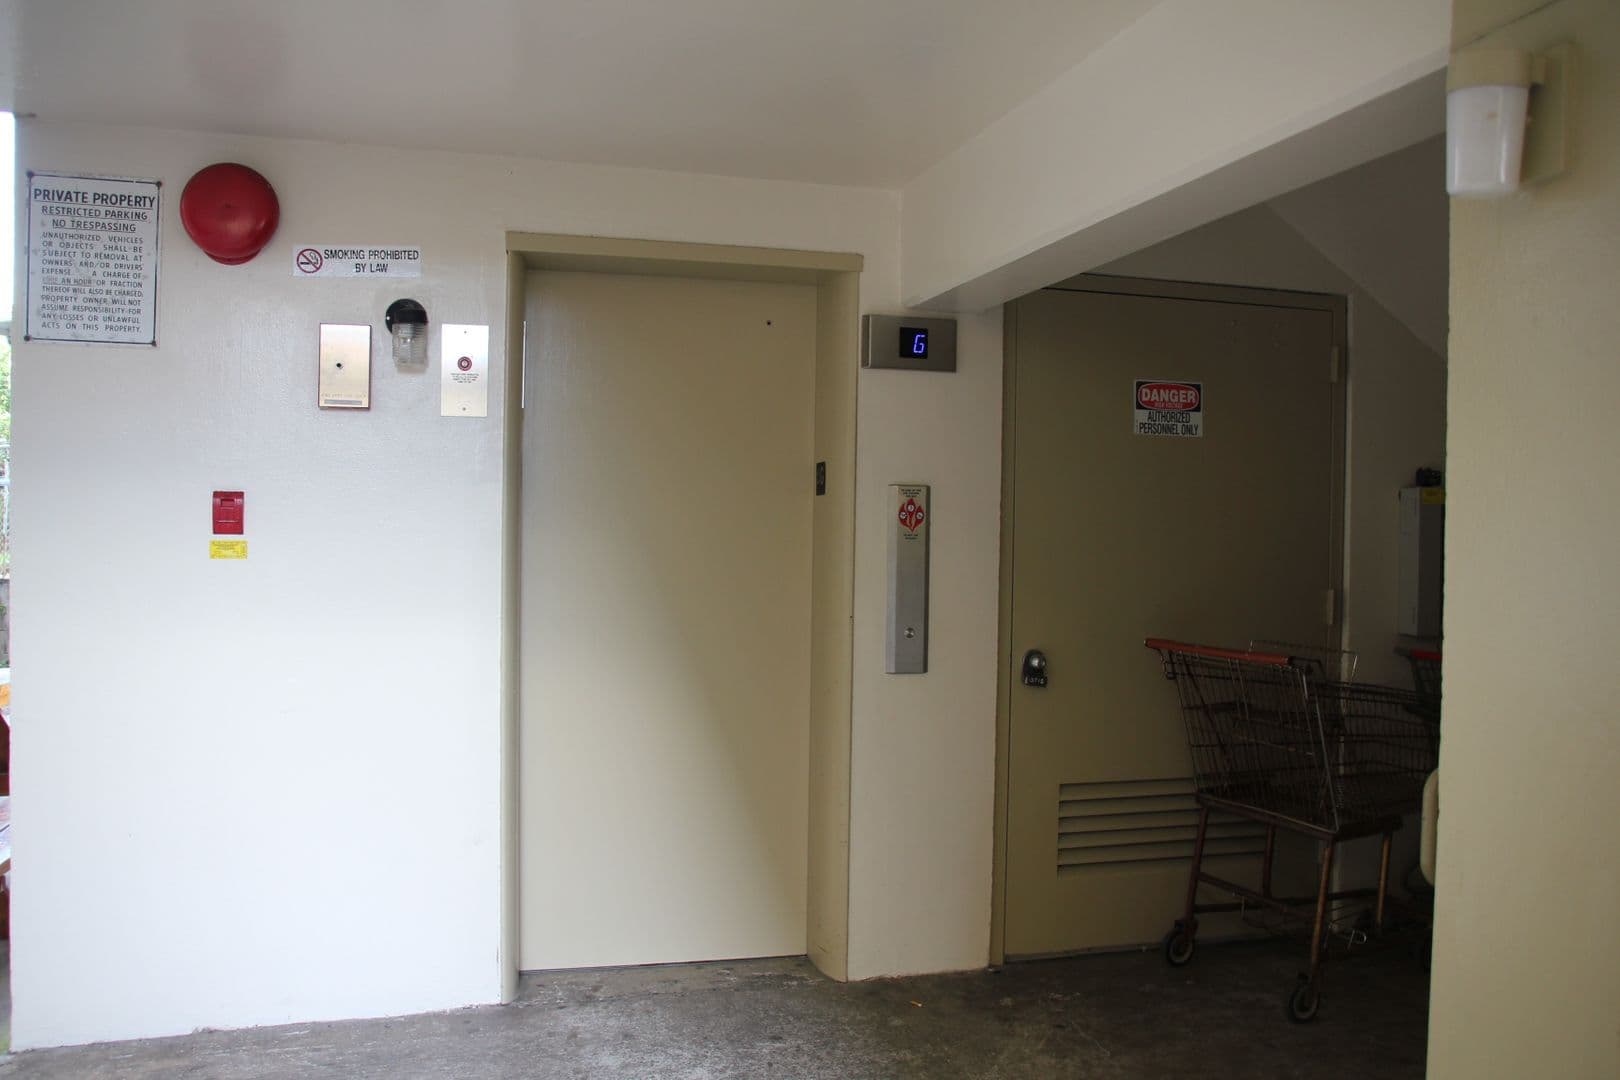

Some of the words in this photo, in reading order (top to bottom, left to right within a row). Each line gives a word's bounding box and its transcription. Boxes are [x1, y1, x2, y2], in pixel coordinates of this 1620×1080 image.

[34, 188, 88, 203] PRIVATE
[92, 192, 156, 208] PROPERTY
[42, 205, 101, 218] RESTRICTED
[105, 210, 148, 220] PARKING
[52, 220, 66, 228] NO
[71, 220, 136, 232] TRESPASSING
[42, 232, 101, 241] UNAUTHORIZED
[108, 236, 143, 244] VEHICLES
[60, 242, 94, 250] OBJECTS
[103, 244, 127, 252] SHALL
[42, 250, 76, 258] SUBJECT
[94, 253, 129, 261] REMOVAL
[323, 249, 365, 260] SMOKING
[368, 250, 419, 260] PROHIBITED
[79, 260, 110, 268] AND/OR
[114, 263, 143, 271] DRIVERS
[355, 263, 366, 273] BY
[370, 264, 389, 273] LAW
[42, 295, 78, 303] PROPERTY
[72, 305, 125, 314] RESPONSIBILITY
[913, 334, 926, 354] G
[1141, 388, 1196, 403] DANGER
[1147, 411, 1190, 423] AUTHORIZED
[1139, 422, 1179, 435] PERSONNEL
[1182, 424, 1199, 435] ONLY
